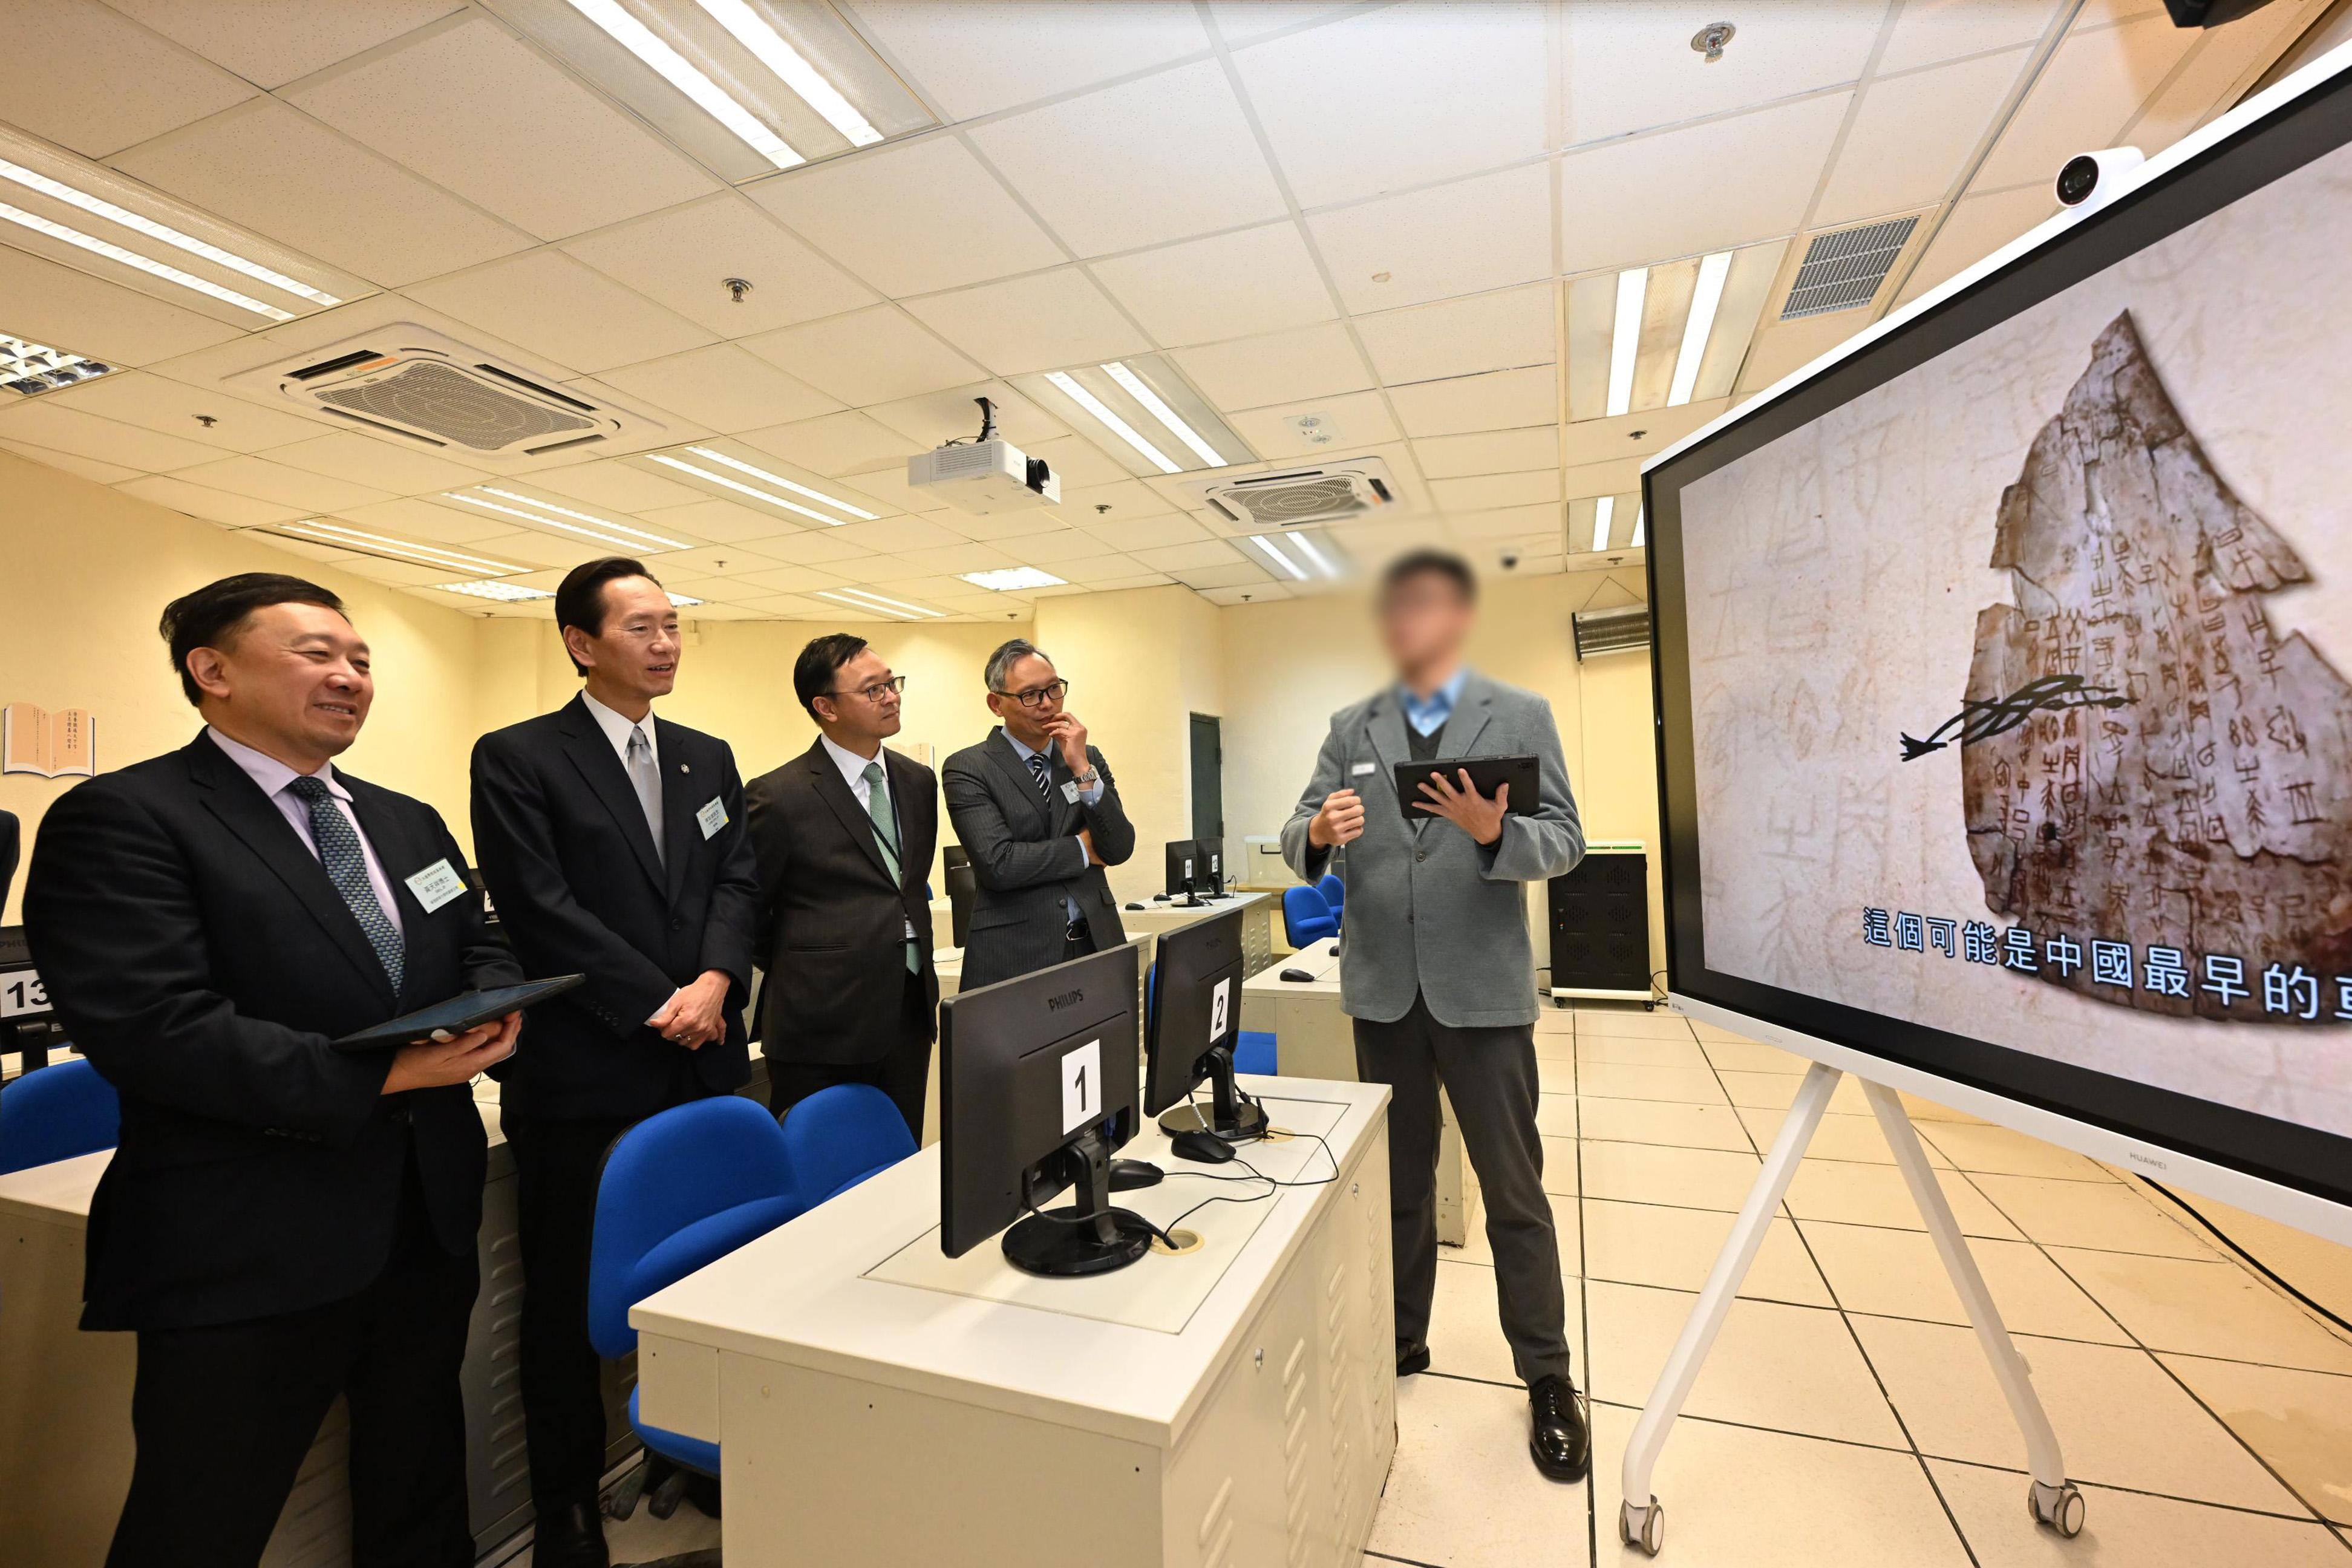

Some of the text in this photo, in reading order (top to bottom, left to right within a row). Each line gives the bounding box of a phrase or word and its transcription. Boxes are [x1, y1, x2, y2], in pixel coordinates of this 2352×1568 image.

[7, 979, 51, 1009] 13
[1047, 988, 1084, 1012] PHILIPS
[1215, 995, 1224, 1031] 2
[1074, 1065, 1086, 1112] 1
[2129, 1152, 2167, 1170] HUAWEI
